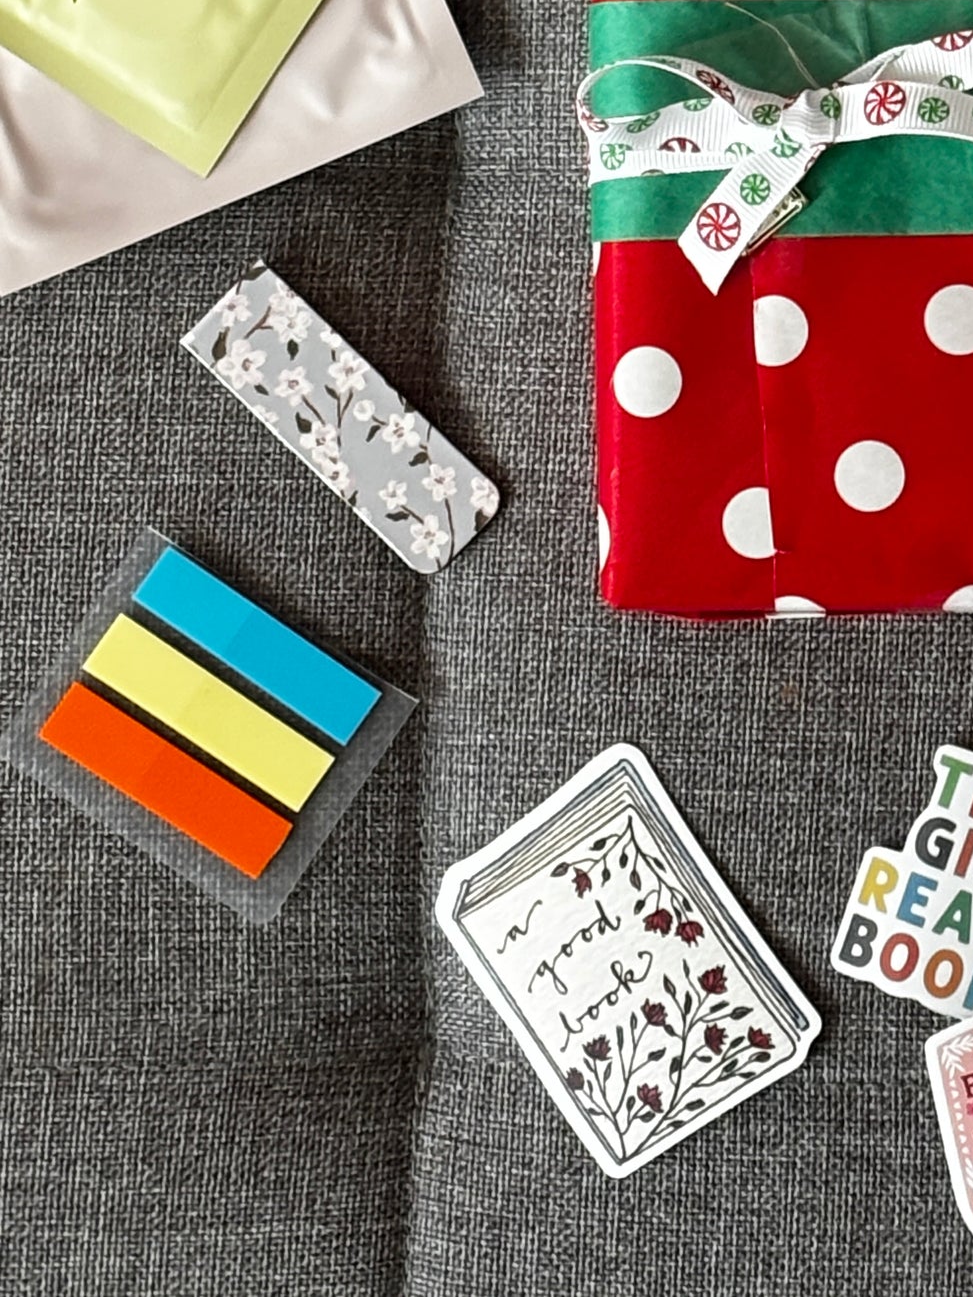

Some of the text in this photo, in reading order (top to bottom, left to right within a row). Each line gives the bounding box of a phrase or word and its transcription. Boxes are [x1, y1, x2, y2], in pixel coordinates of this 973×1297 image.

[497, 900, 543, 954] a
[528, 900, 621, 995] good
[560, 950, 653, 1053] book
